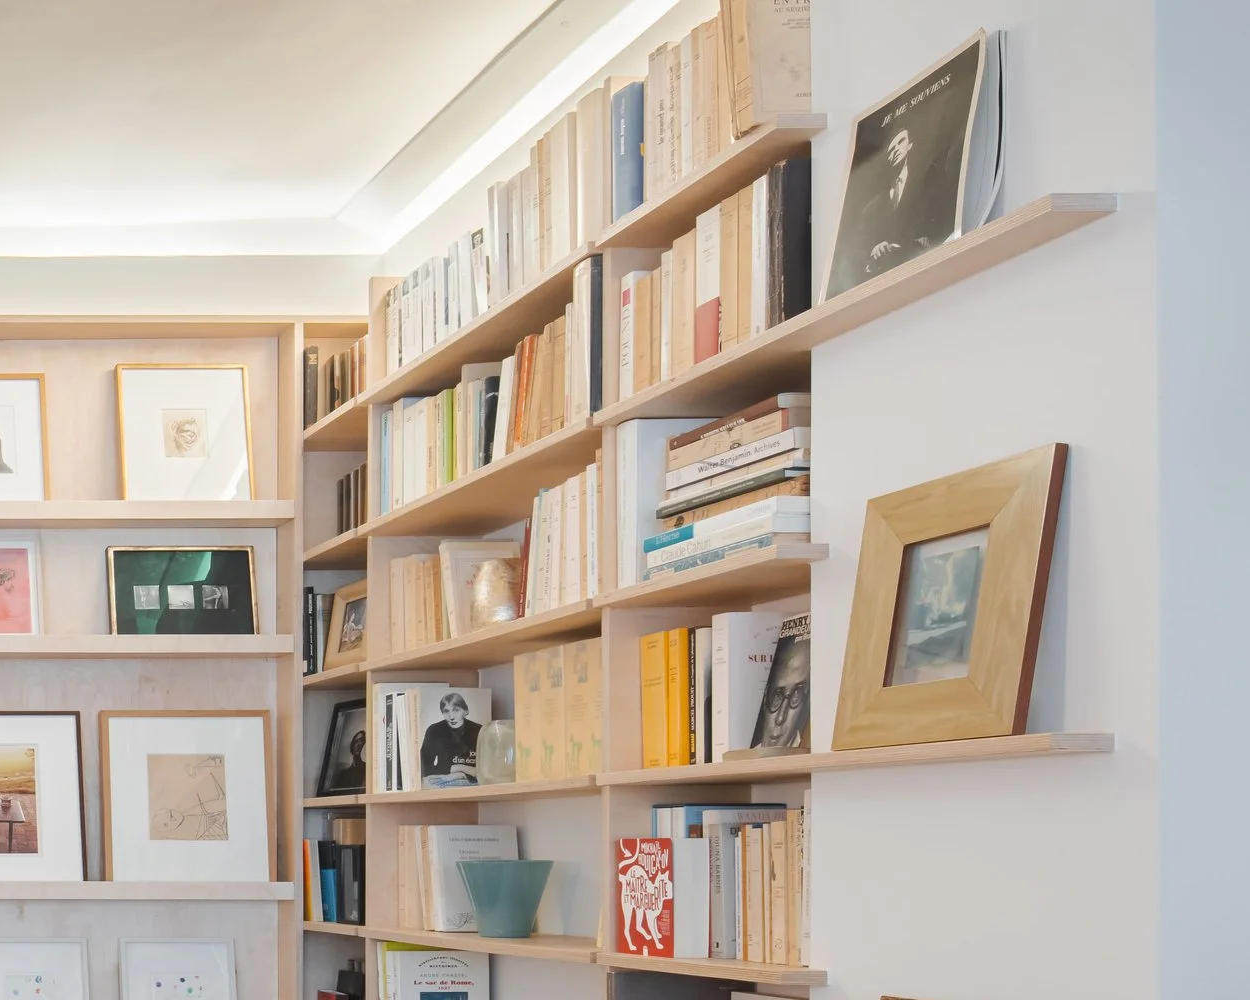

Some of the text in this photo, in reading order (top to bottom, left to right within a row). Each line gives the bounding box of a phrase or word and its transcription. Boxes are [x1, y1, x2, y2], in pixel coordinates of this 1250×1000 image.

[881, 73, 951, 127] JE ME SOUVIENS
[697, 461, 721, 474] Walter
[753, 439, 781, 455] Archives
[660, 536, 711, 563] Claude Cahun
[781, 615, 809, 630] HENRY
[748, 654, 767, 663] SUR
